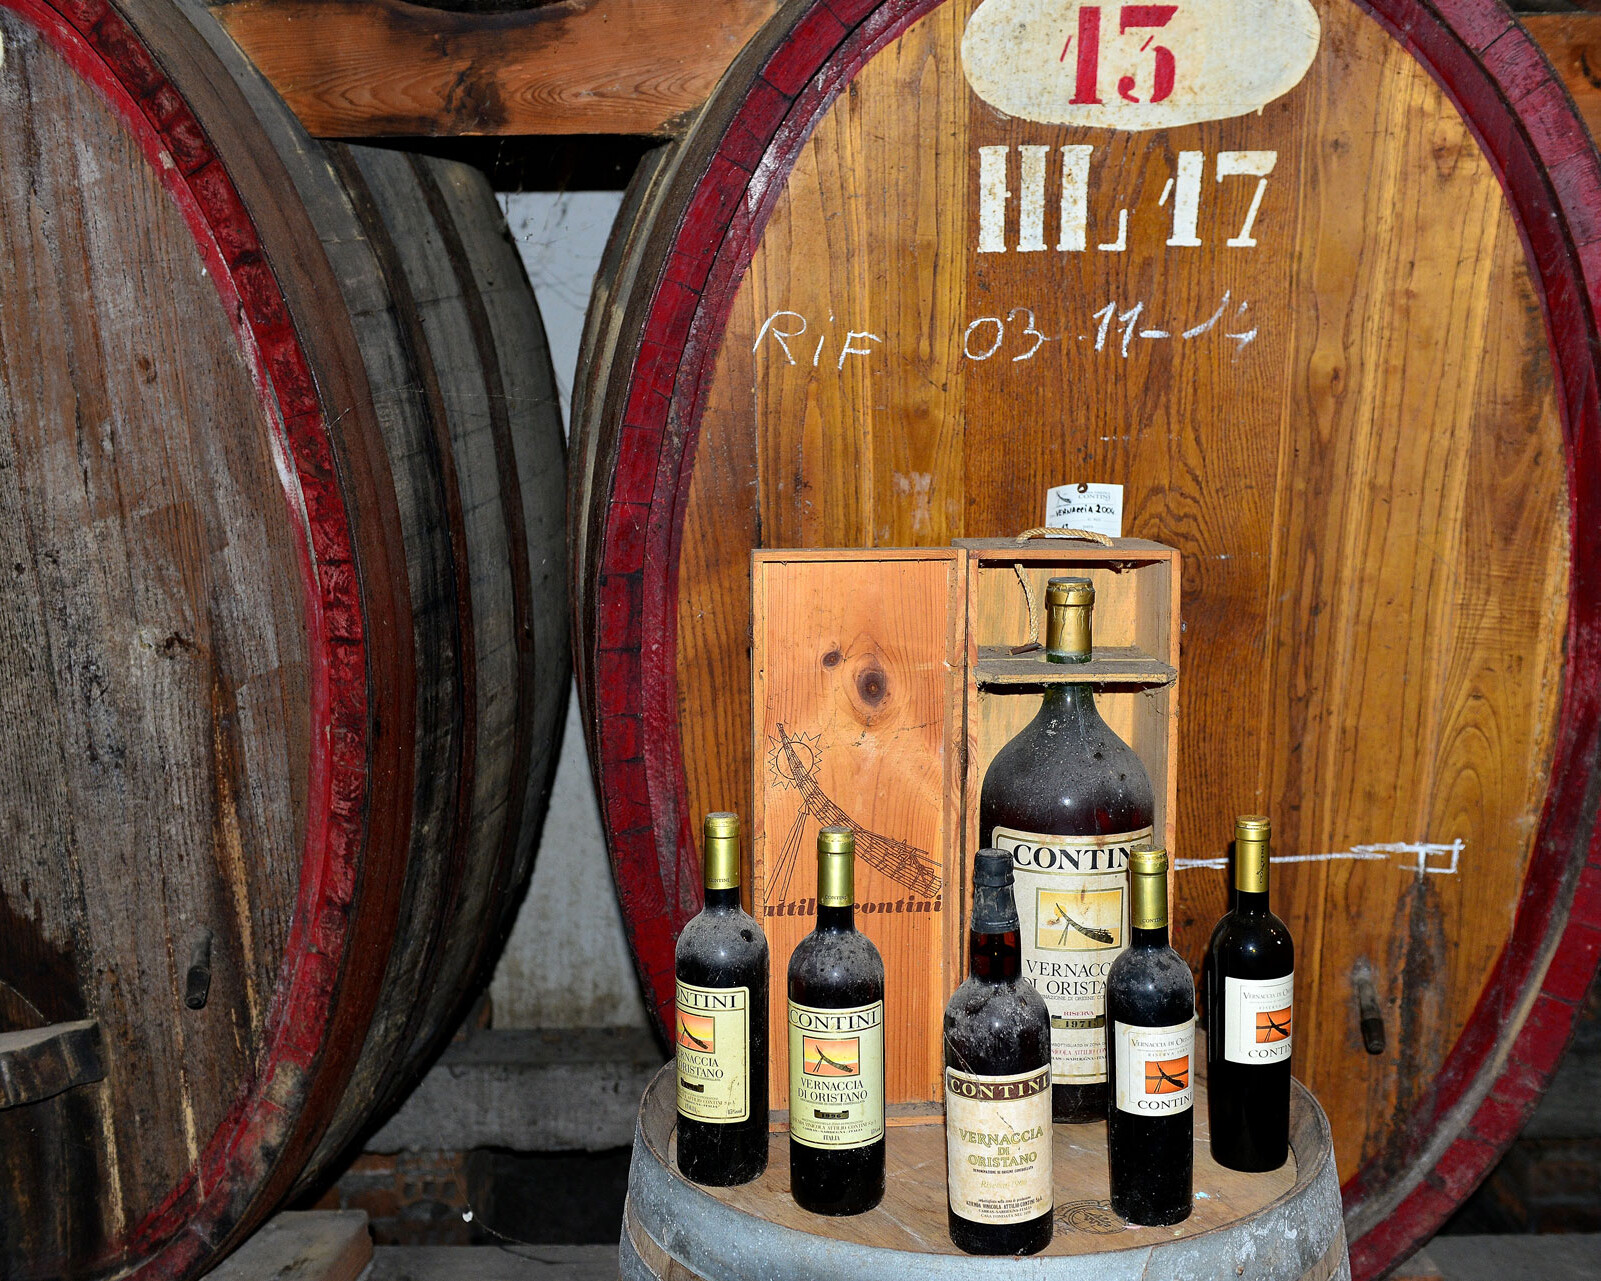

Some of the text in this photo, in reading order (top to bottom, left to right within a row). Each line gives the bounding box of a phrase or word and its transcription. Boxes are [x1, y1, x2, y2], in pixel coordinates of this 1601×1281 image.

[1013, 844, 1130, 871] CONTIN
[1025, 959, 1111, 978] VERNACC
[676, 985, 737, 1008] ONTINI
[1046, 980, 1106, 996] ORISTA
[790, 1009, 878, 1031] CONTINI
[1248, 1043, 1292, 1058] CONTIN
[801, 1077, 864, 1092] VERNACCIA
[950, 1075, 1048, 1099] CONTINI
[798, 1087, 807, 1099] DI
[810, 1089, 868, 1103] ORISTANO
[959, 1126, 1044, 1148] VERNACCIA
[967, 1152, 1038, 1168] ORISTANO
[997, 1147, 1010, 1156] DI
